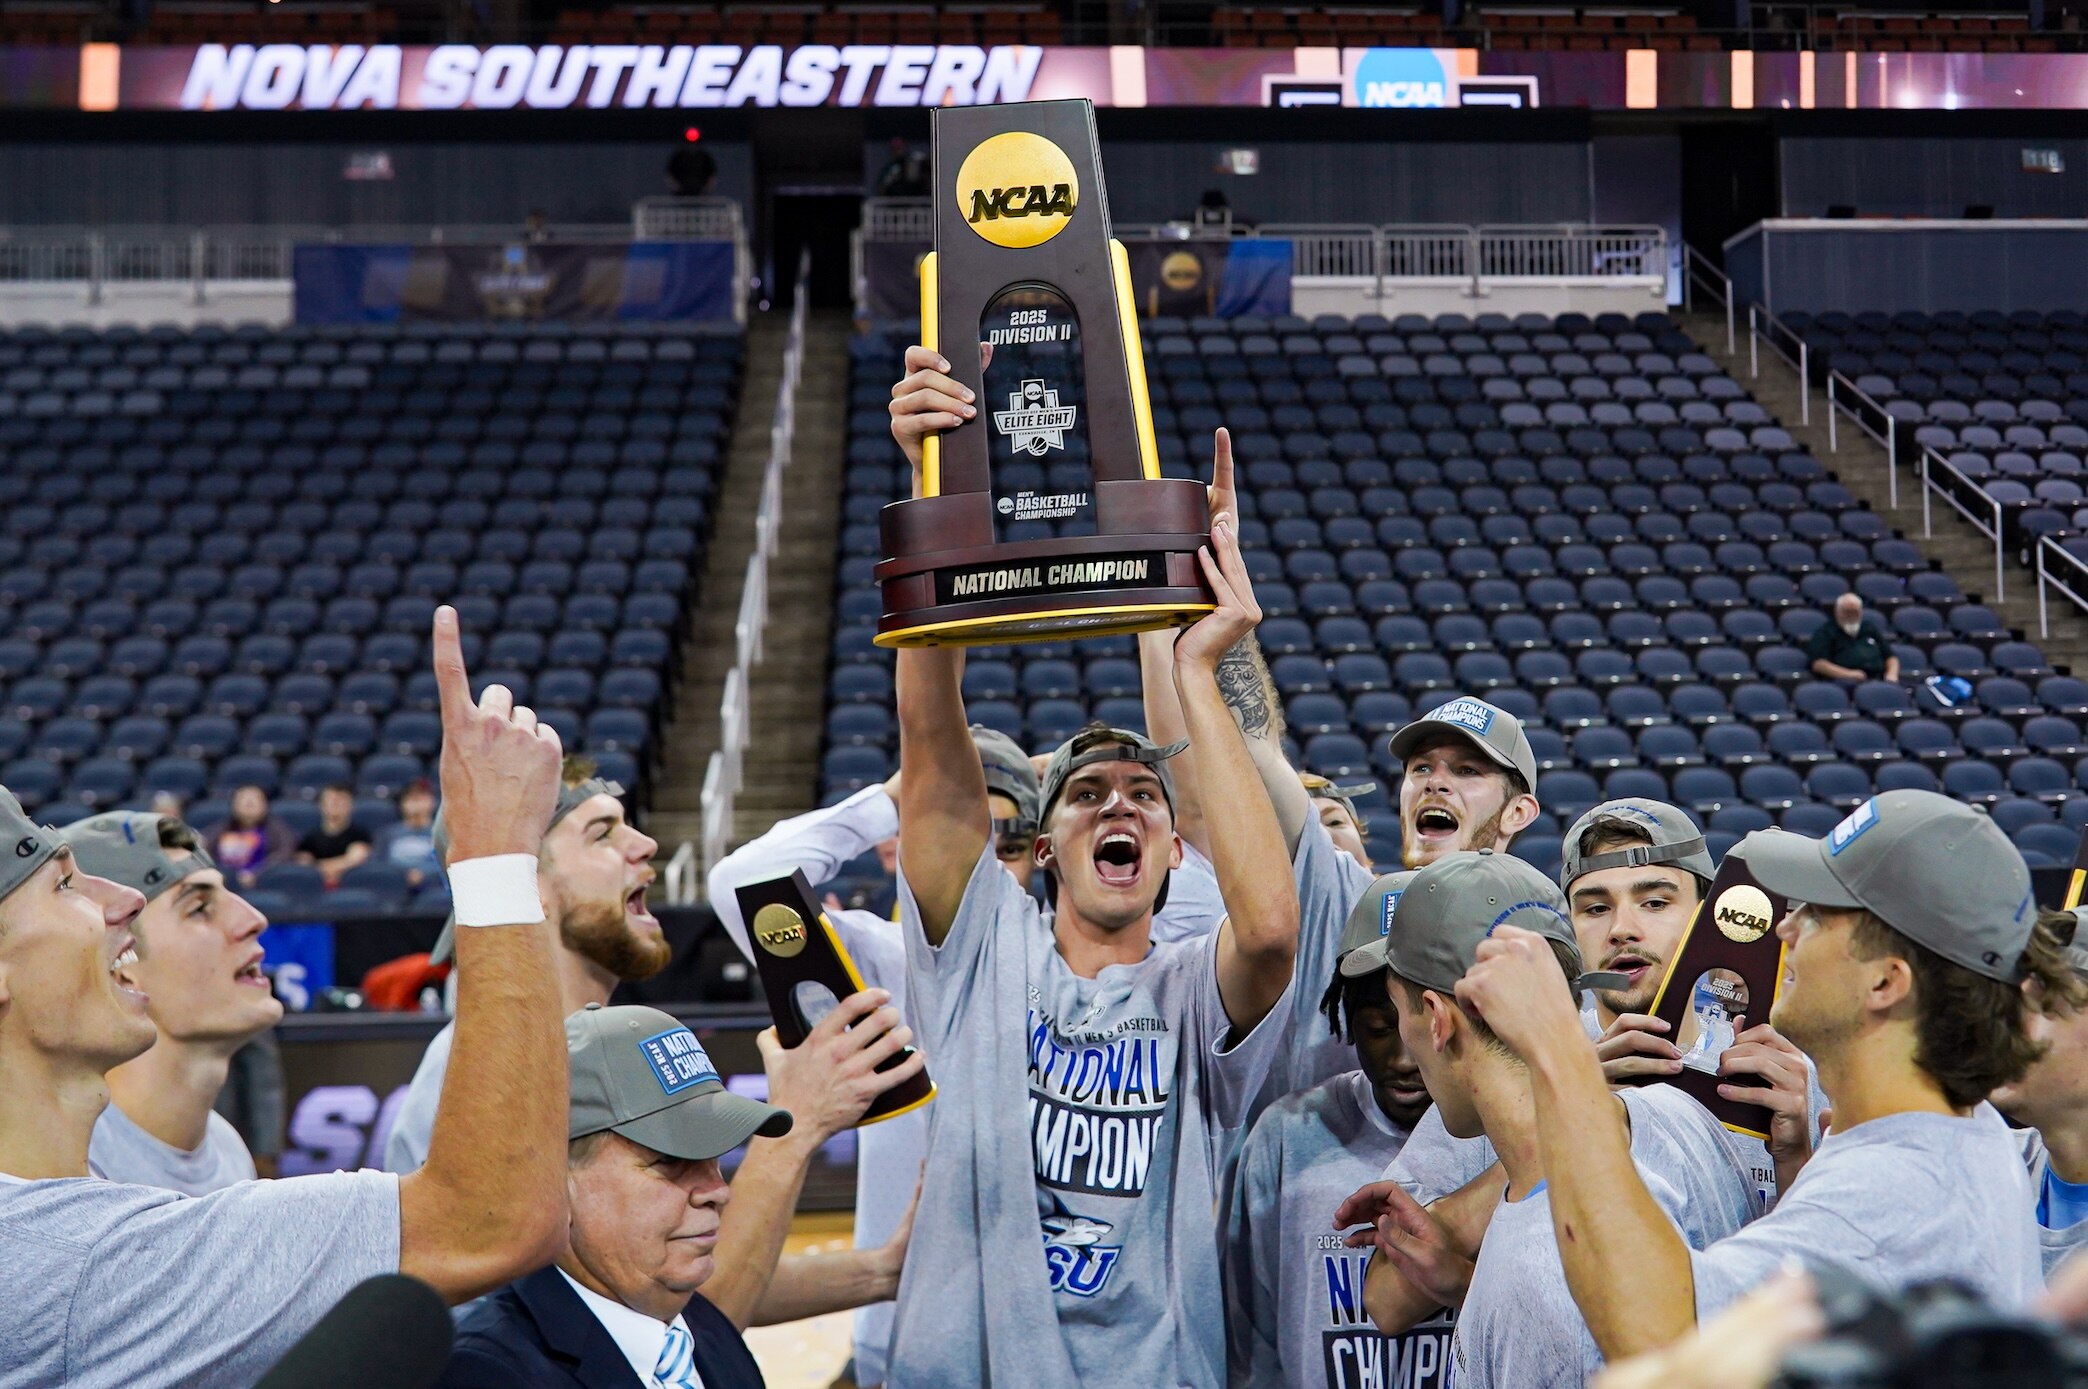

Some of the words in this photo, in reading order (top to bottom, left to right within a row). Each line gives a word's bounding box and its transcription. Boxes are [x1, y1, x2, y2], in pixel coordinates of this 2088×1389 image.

[180, 43, 403, 110] NOVA
[420, 44, 1043, 109] SOUTHEASTERN
[1364, 81, 1445, 108] NCAA
[968, 183, 1077, 223] NCAA
[1009, 309, 1047, 326] 2025
[989, 325, 1057, 346] DIVISION
[1060, 324, 1071, 341] II
[1004, 415, 1034, 429] ELITE
[1036, 412, 1070, 426] EIGHT
[1015, 493, 1089, 511] BASKETBALL
[1014, 507, 1077, 521] CHAMPIONSHIP
[952, 566, 1042, 596] NATIONAL
[1047, 559, 1149, 586] CHAMPION
[1717, 907, 1768, 934] NCAA
[1701, 983, 1735, 1001] DIVISION
[1712, 977, 1735, 990] 2025
[1027, 1020, 1170, 1107] ATIONAL
[1317, 1234, 1344, 1250] 2025
[1042, 1233, 1123, 1297] SU
